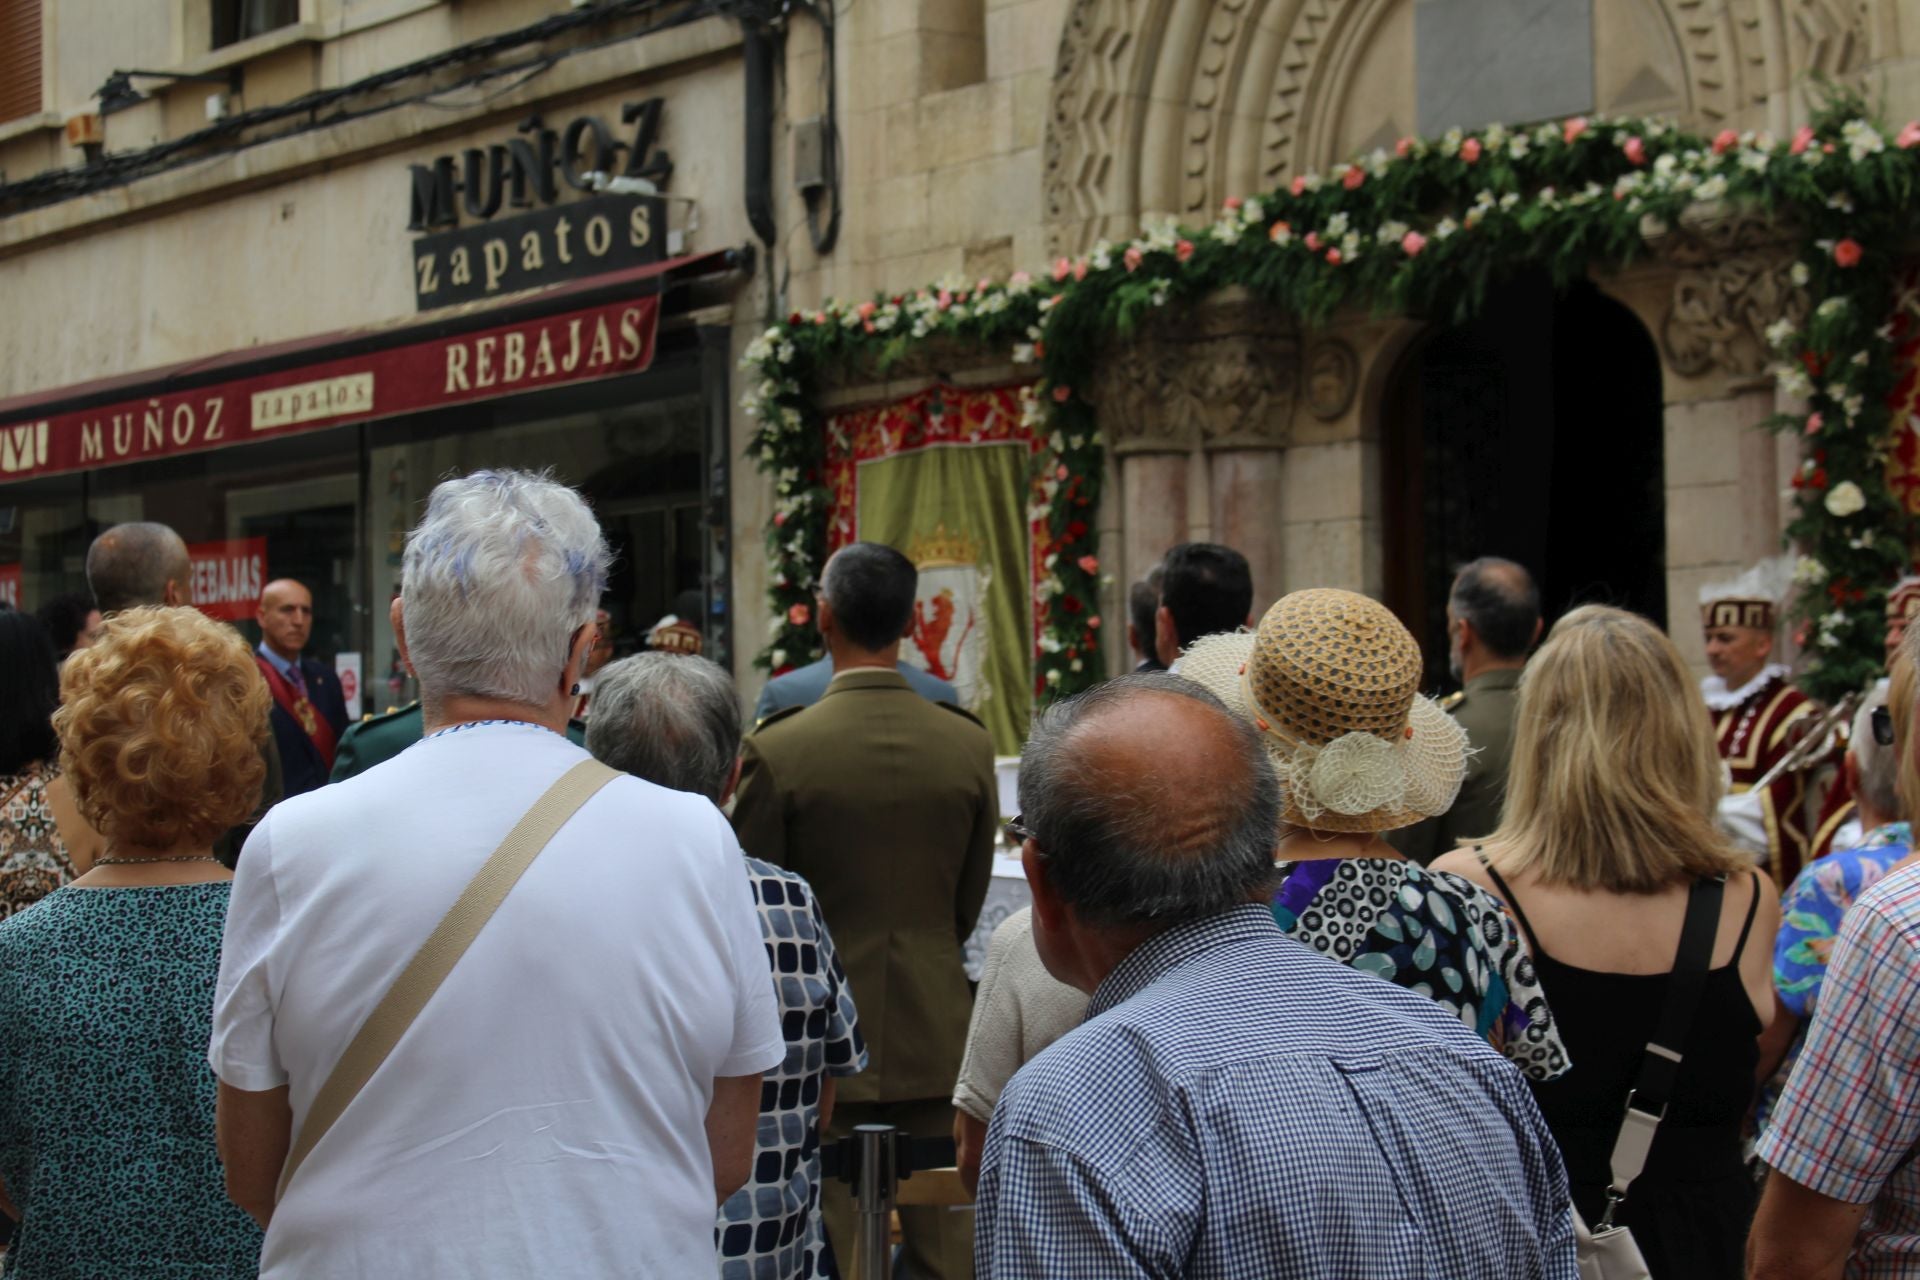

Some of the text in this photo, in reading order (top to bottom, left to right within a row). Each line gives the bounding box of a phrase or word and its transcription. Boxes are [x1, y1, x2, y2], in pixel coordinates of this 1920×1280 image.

[406, 97, 673, 232] MUÑOZ
[417, 205, 651, 294] zapatos
[80, 397, 225, 463] MUÑOZ
[261, 382, 364, 422] zapatos
[444, 308, 643, 394] REBAJAS
